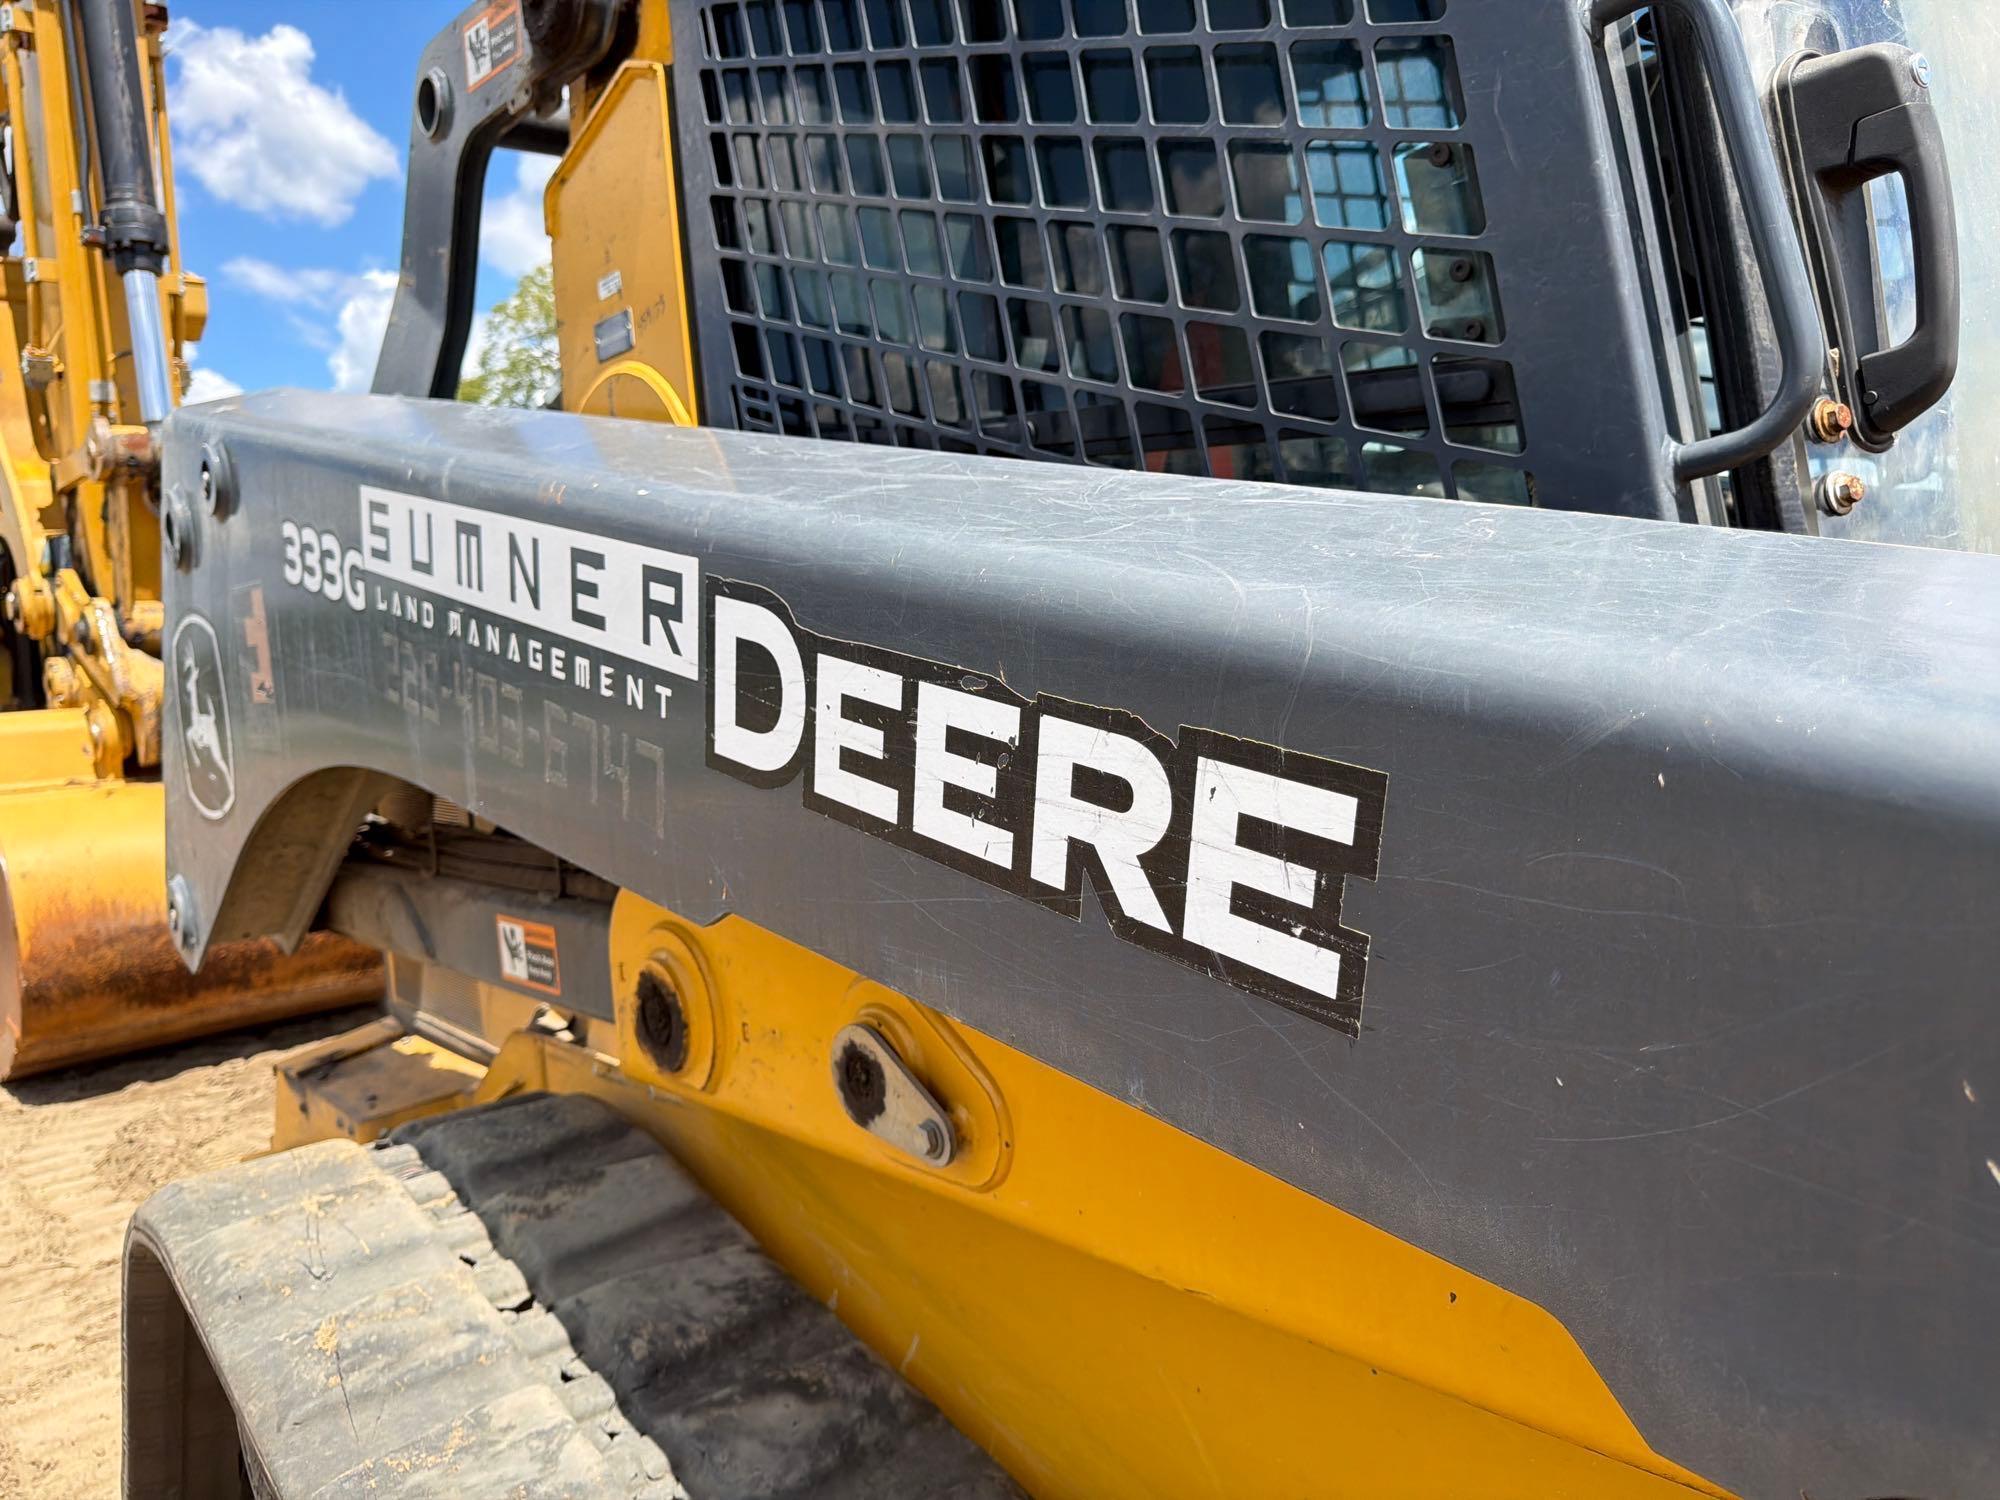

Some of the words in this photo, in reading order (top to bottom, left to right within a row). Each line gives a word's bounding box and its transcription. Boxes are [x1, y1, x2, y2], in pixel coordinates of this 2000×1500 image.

[282, 520, 366, 612] 333G
[368, 500, 684, 657] SUMNER
[374, 585, 435, 630] LAND
[448, 610, 673, 719] MANAGEMENT
[713, 595, 1359, 1000] DEERE
